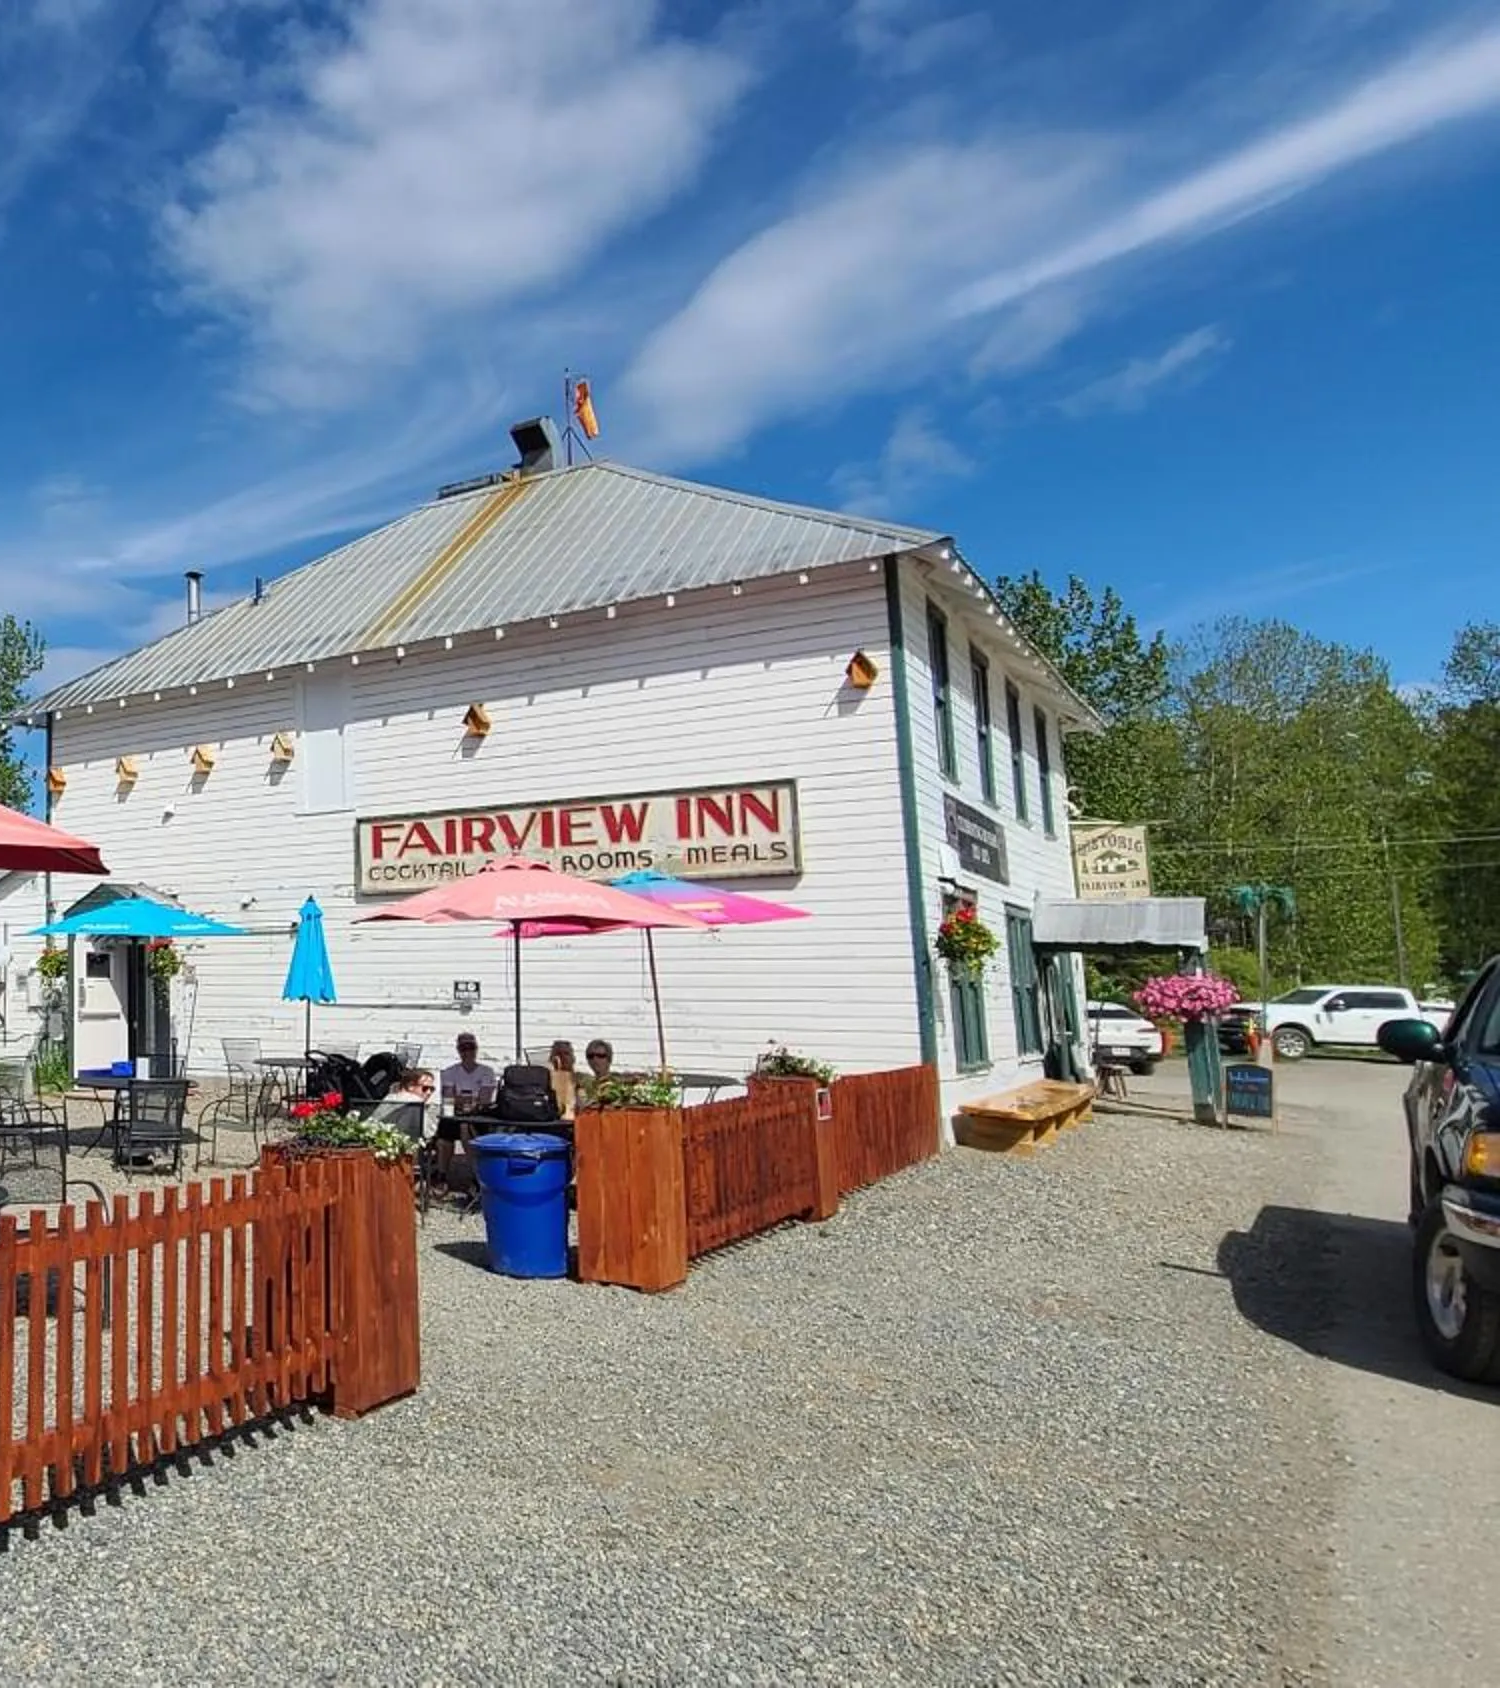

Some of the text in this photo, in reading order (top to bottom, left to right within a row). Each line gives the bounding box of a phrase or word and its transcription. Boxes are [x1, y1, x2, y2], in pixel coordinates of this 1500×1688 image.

[371, 789, 780, 860] FAIRVIEW INN
[562, 849, 653, 872] ROOMS
[686, 841, 789, 865] MEALS
